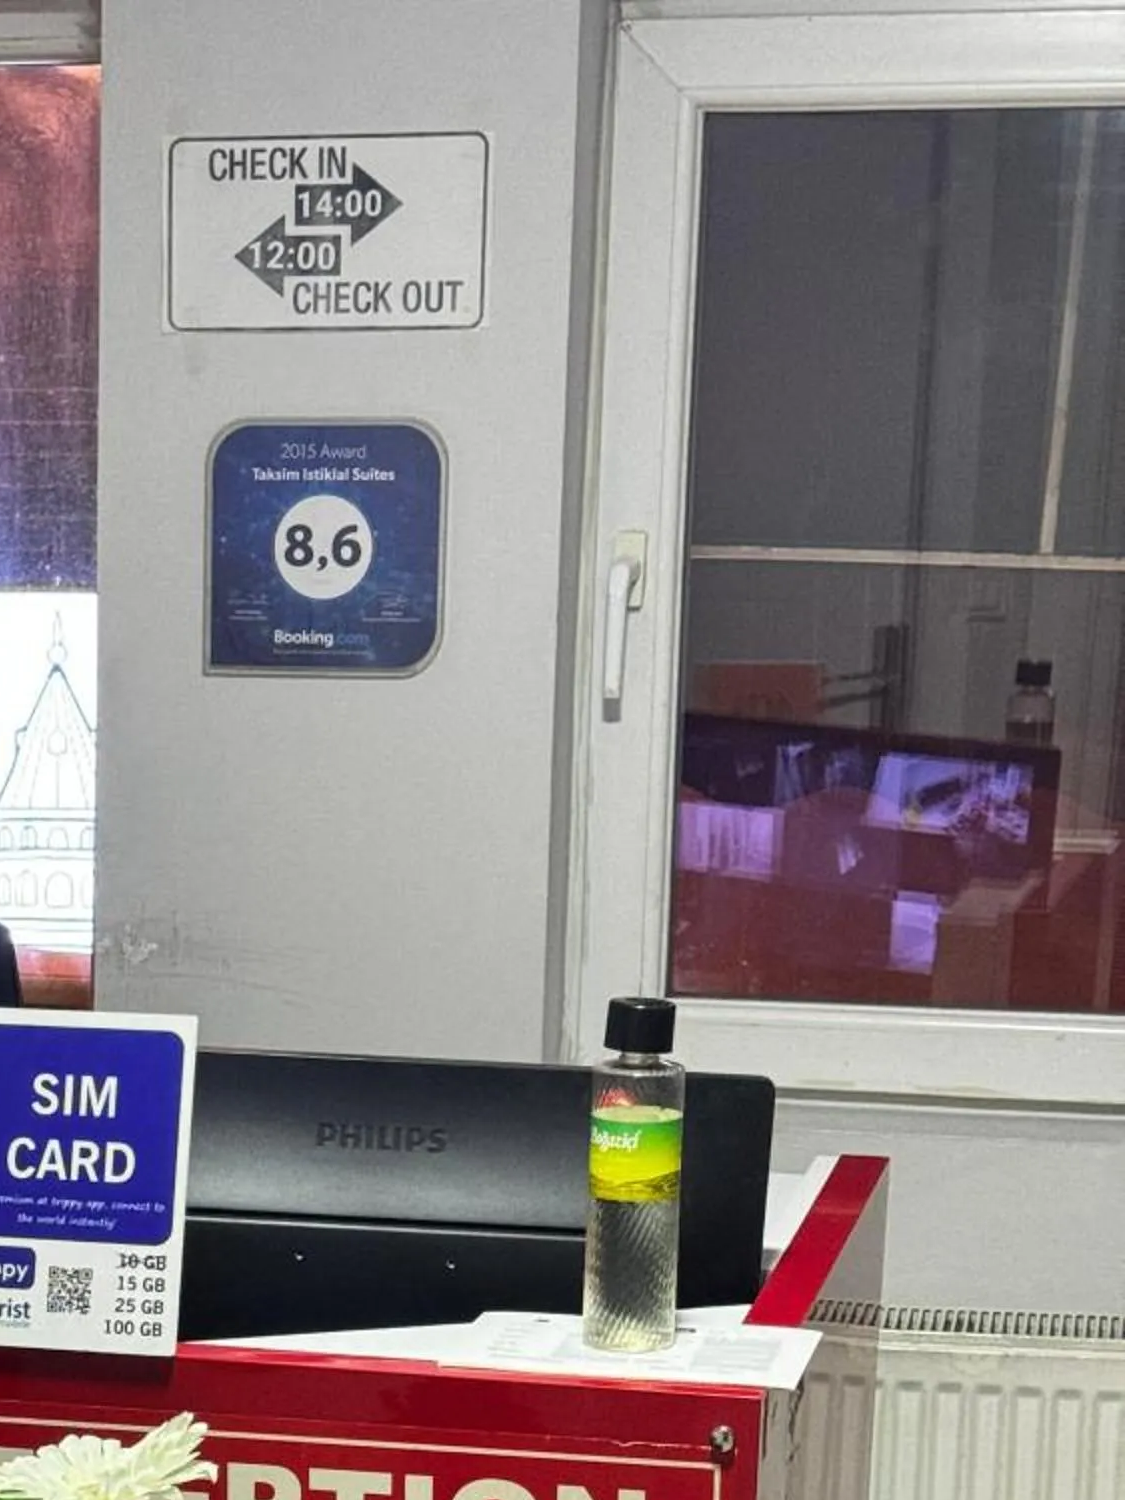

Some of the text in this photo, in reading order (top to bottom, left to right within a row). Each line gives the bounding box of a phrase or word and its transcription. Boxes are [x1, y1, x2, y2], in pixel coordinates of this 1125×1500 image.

[208, 146, 347, 181] CHECK IN
[297, 189, 382, 219] 14:00
[248, 241, 336, 270] 12:00
[292, 280, 465, 315] CHECK OUT
[280, 442, 367, 459] 2015 Award
[252, 467, 300, 481] Taksim
[352, 467, 396, 481] Suites
[284, 523, 362, 571] 8,6
[31, 1072, 118, 1119] SIM
[315, 1121, 448, 1154] PHILIPS
[6, 1136, 136, 1184] CARD
[143, 1255, 167, 1271] GB
[116, 1275, 165, 1293] 15 GB
[114, 1298, 164, 1315] 25 GB
[103, 1319, 163, 1337] 100 GB
